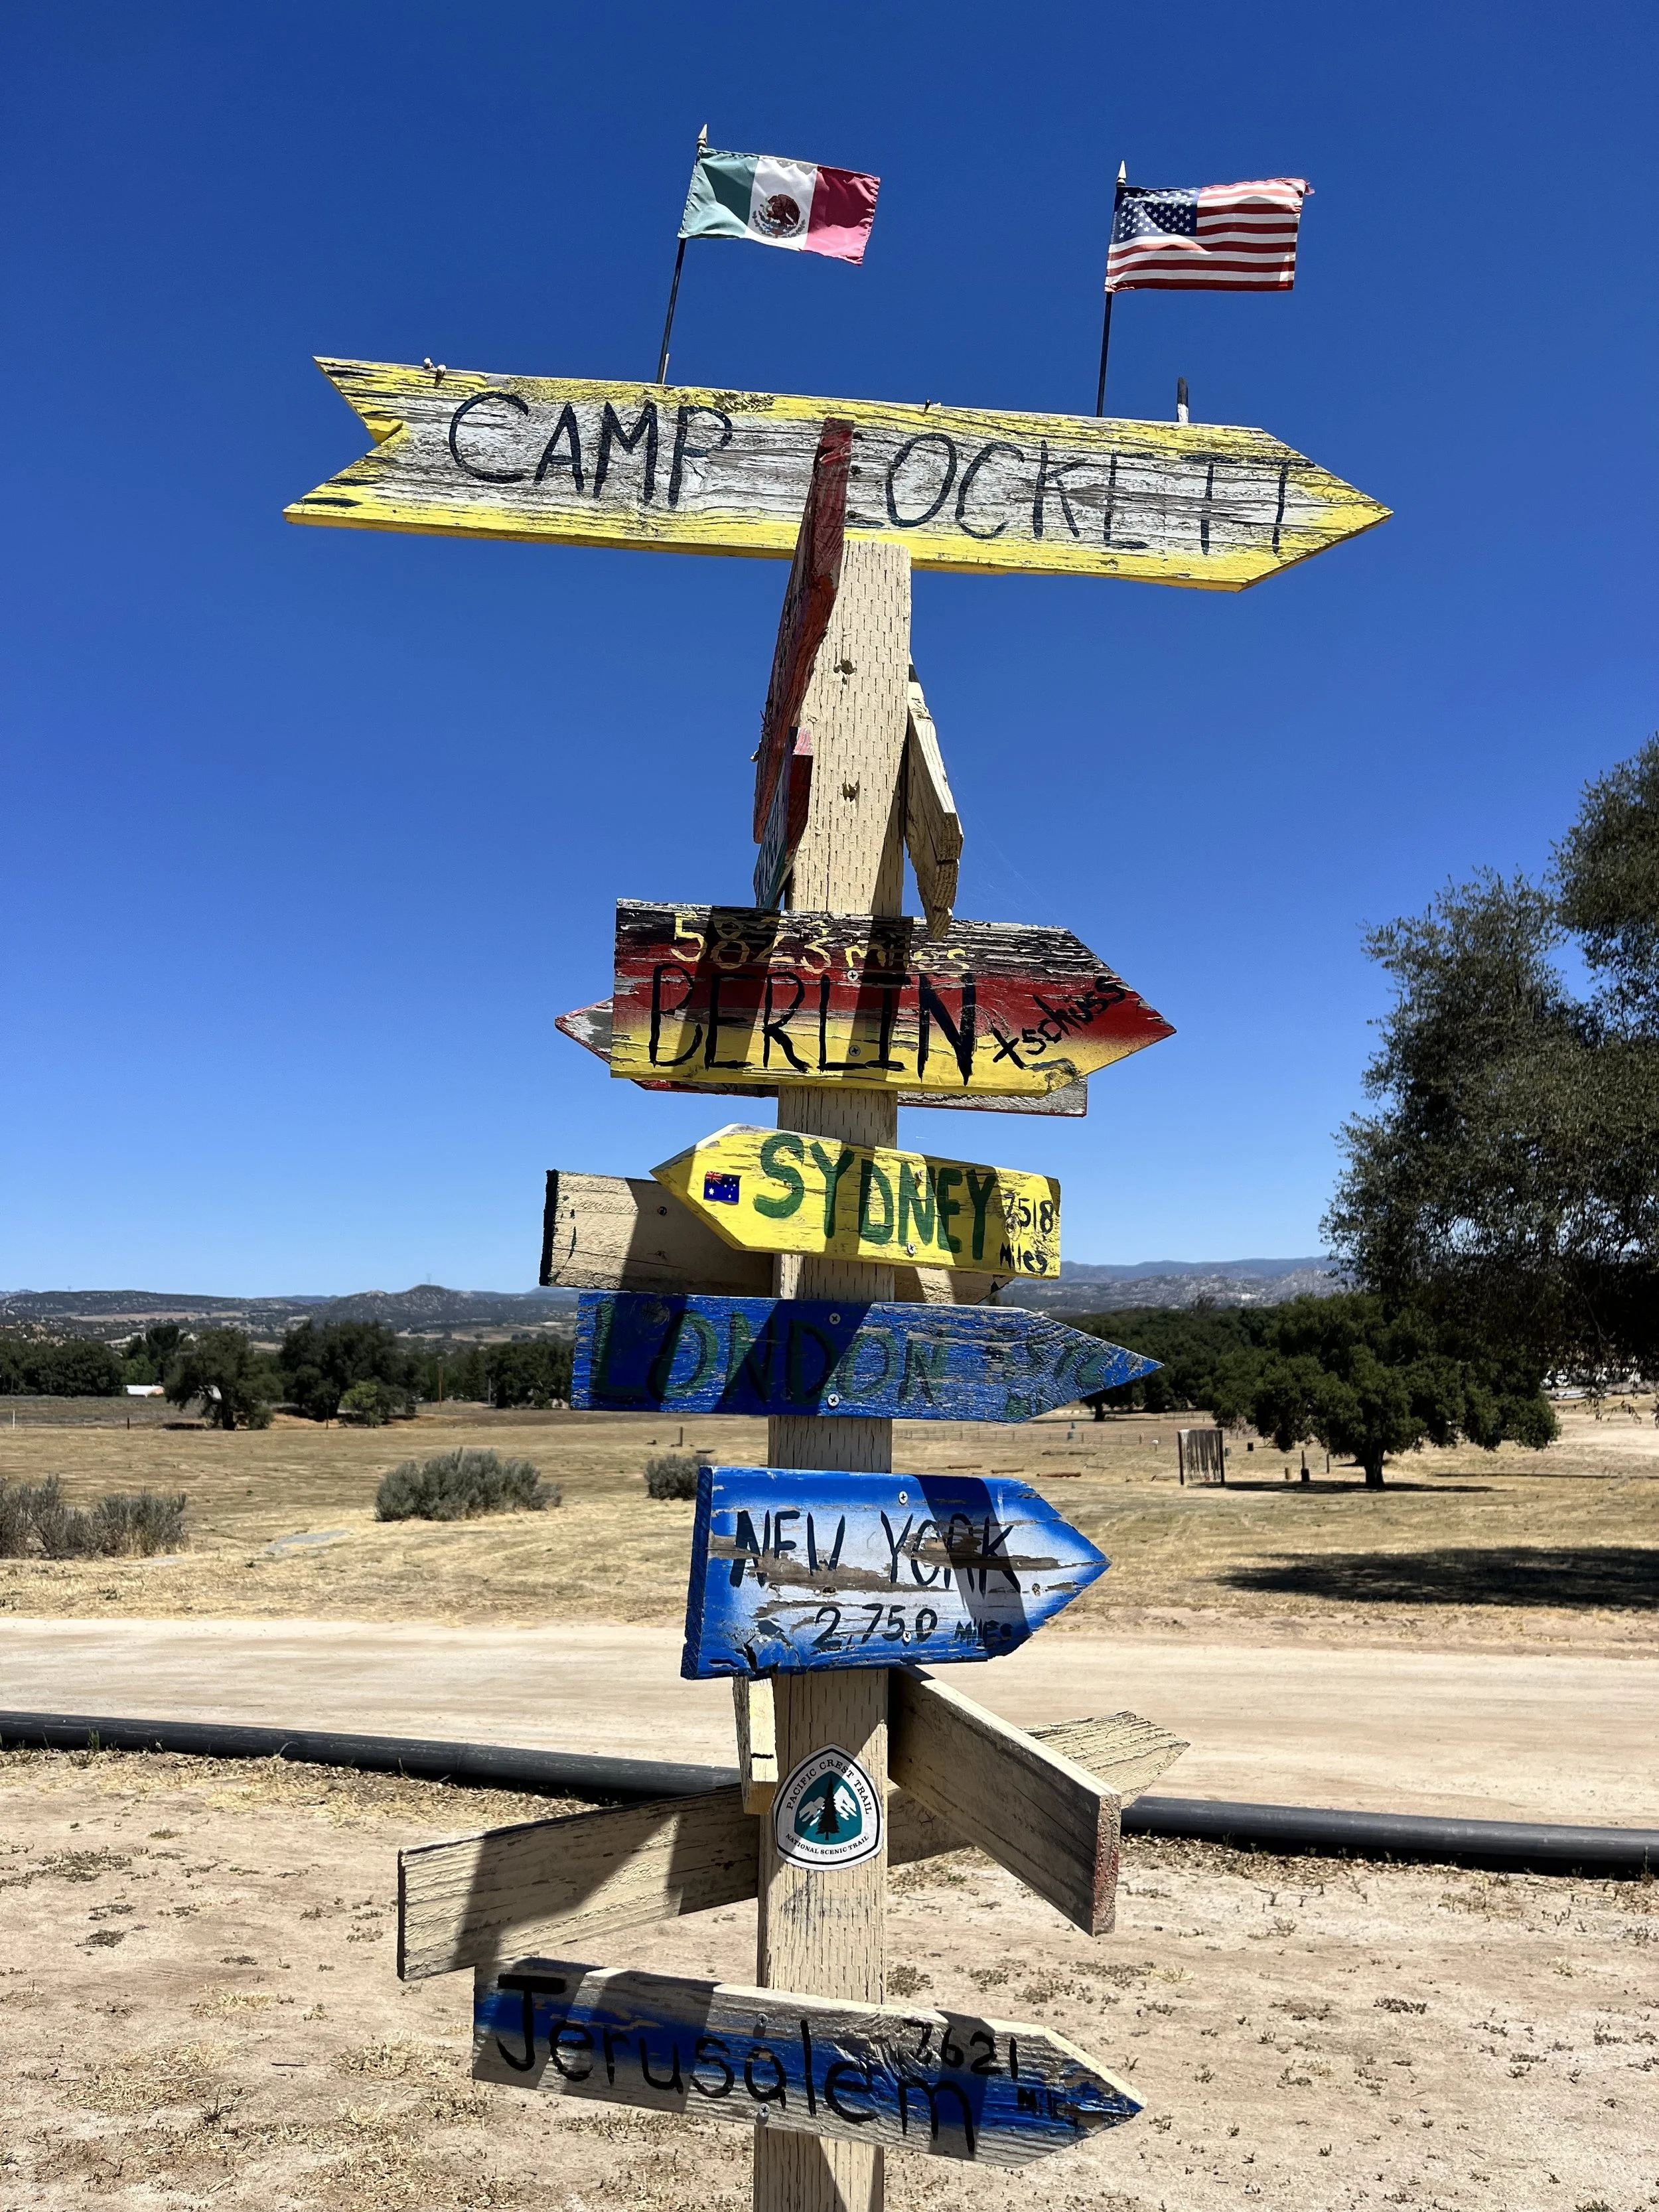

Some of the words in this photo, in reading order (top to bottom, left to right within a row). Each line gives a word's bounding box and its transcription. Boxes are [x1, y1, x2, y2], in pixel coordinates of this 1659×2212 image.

[449, 392, 732, 508] CAMP
[844, 433, 1317, 556] OCKETT
[649, 962, 977, 1086] BERLIN
[753, 1132, 997, 1261] SYDNEY
[1003, 1192, 1054, 1234] 7518
[593, 1300, 946, 1407] LONDON
[880, 1512, 1022, 1594] YORK
[786, 1768, 817, 1810] PACIFIC
[819, 1759, 854, 1779] CREST
[853, 1780, 873, 1814] TRAIL
[785, 1833, 820, 1854] NATIONAL
[820, 1846, 848, 1855] SCENIC
[847, 1834, 870, 1851] TRAIL
[495, 1974, 977, 2156] Jerusalem
